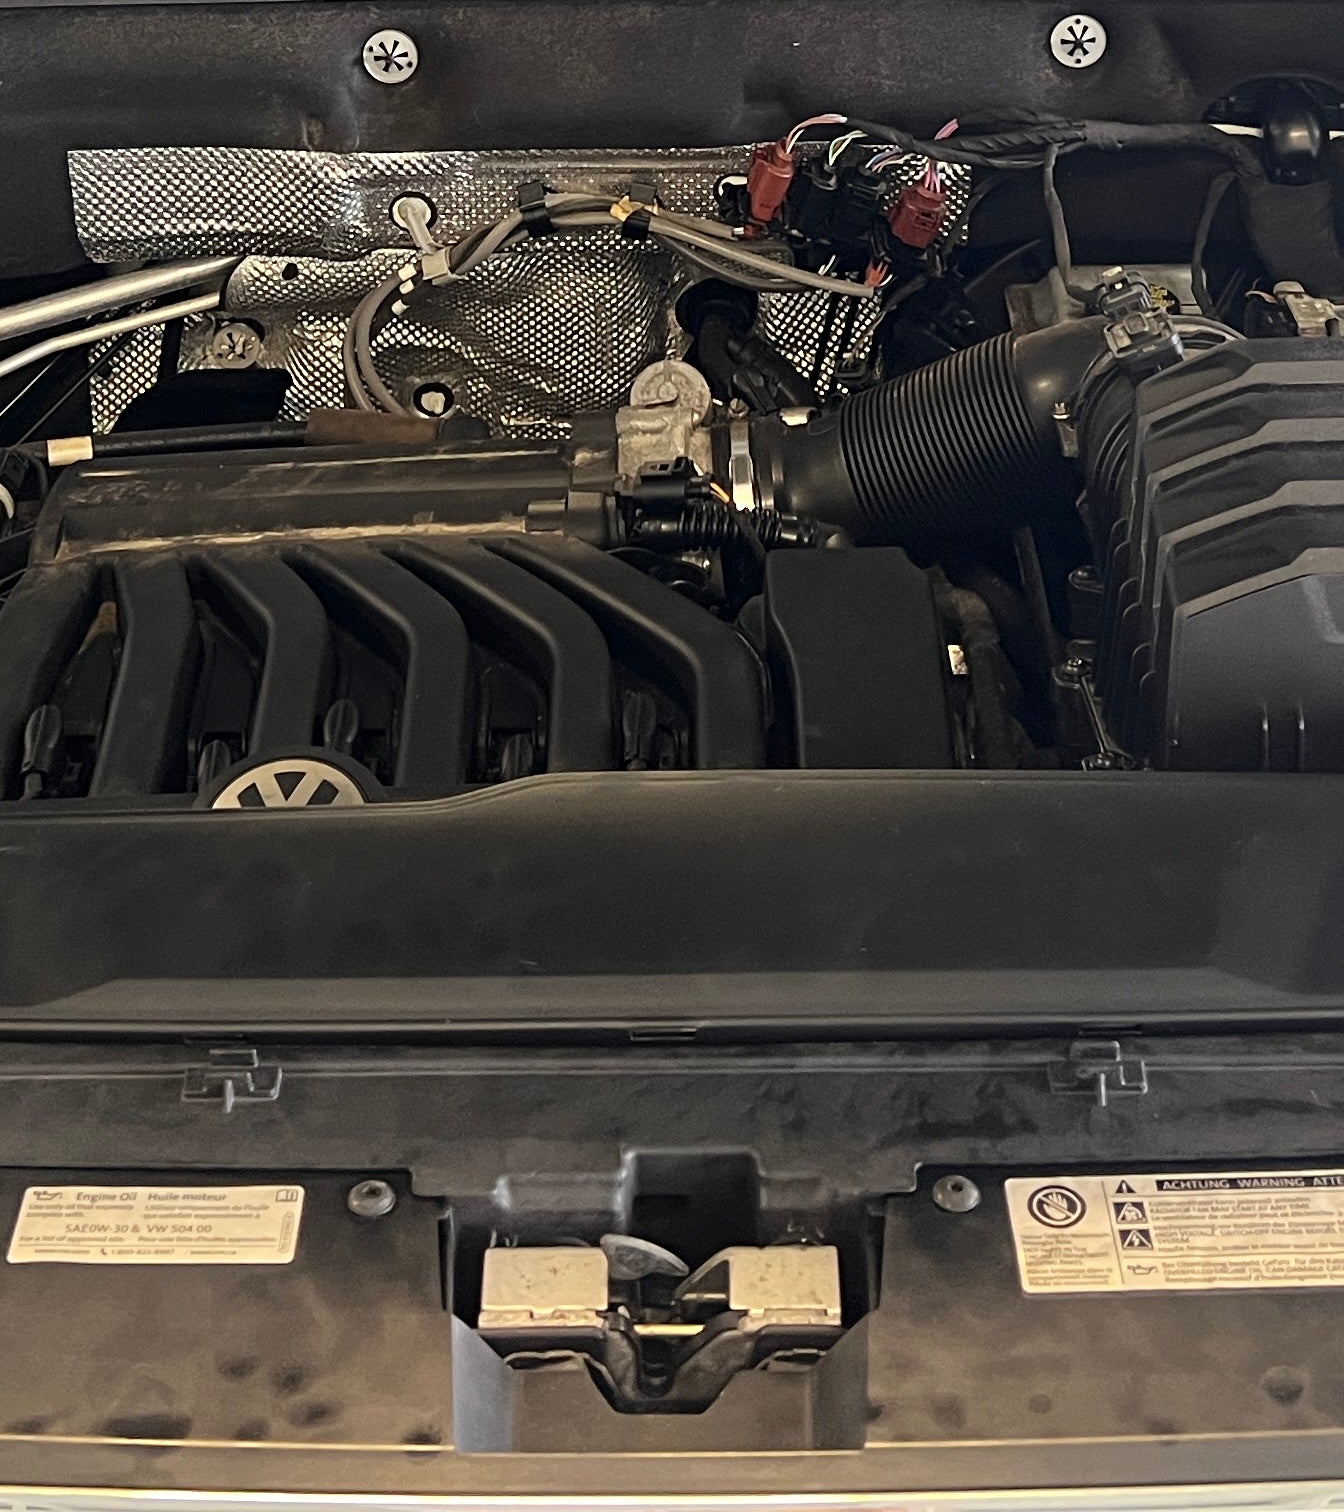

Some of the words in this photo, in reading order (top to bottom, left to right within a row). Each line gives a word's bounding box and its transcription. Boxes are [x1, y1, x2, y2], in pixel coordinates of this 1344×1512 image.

[1162, 1178, 1230, 1191] ACHTUNG
[1236, 1176, 1306, 1189] WARNING
[76, 1191, 117, 1203] Engine
[119, 1191, 138, 1202] Oil
[147, 1192, 180, 1201] Huile
[181, 1193, 228, 1202] moteur
[147, 1223, 169, 1234] VW
[196, 1223, 213, 1234] 00
